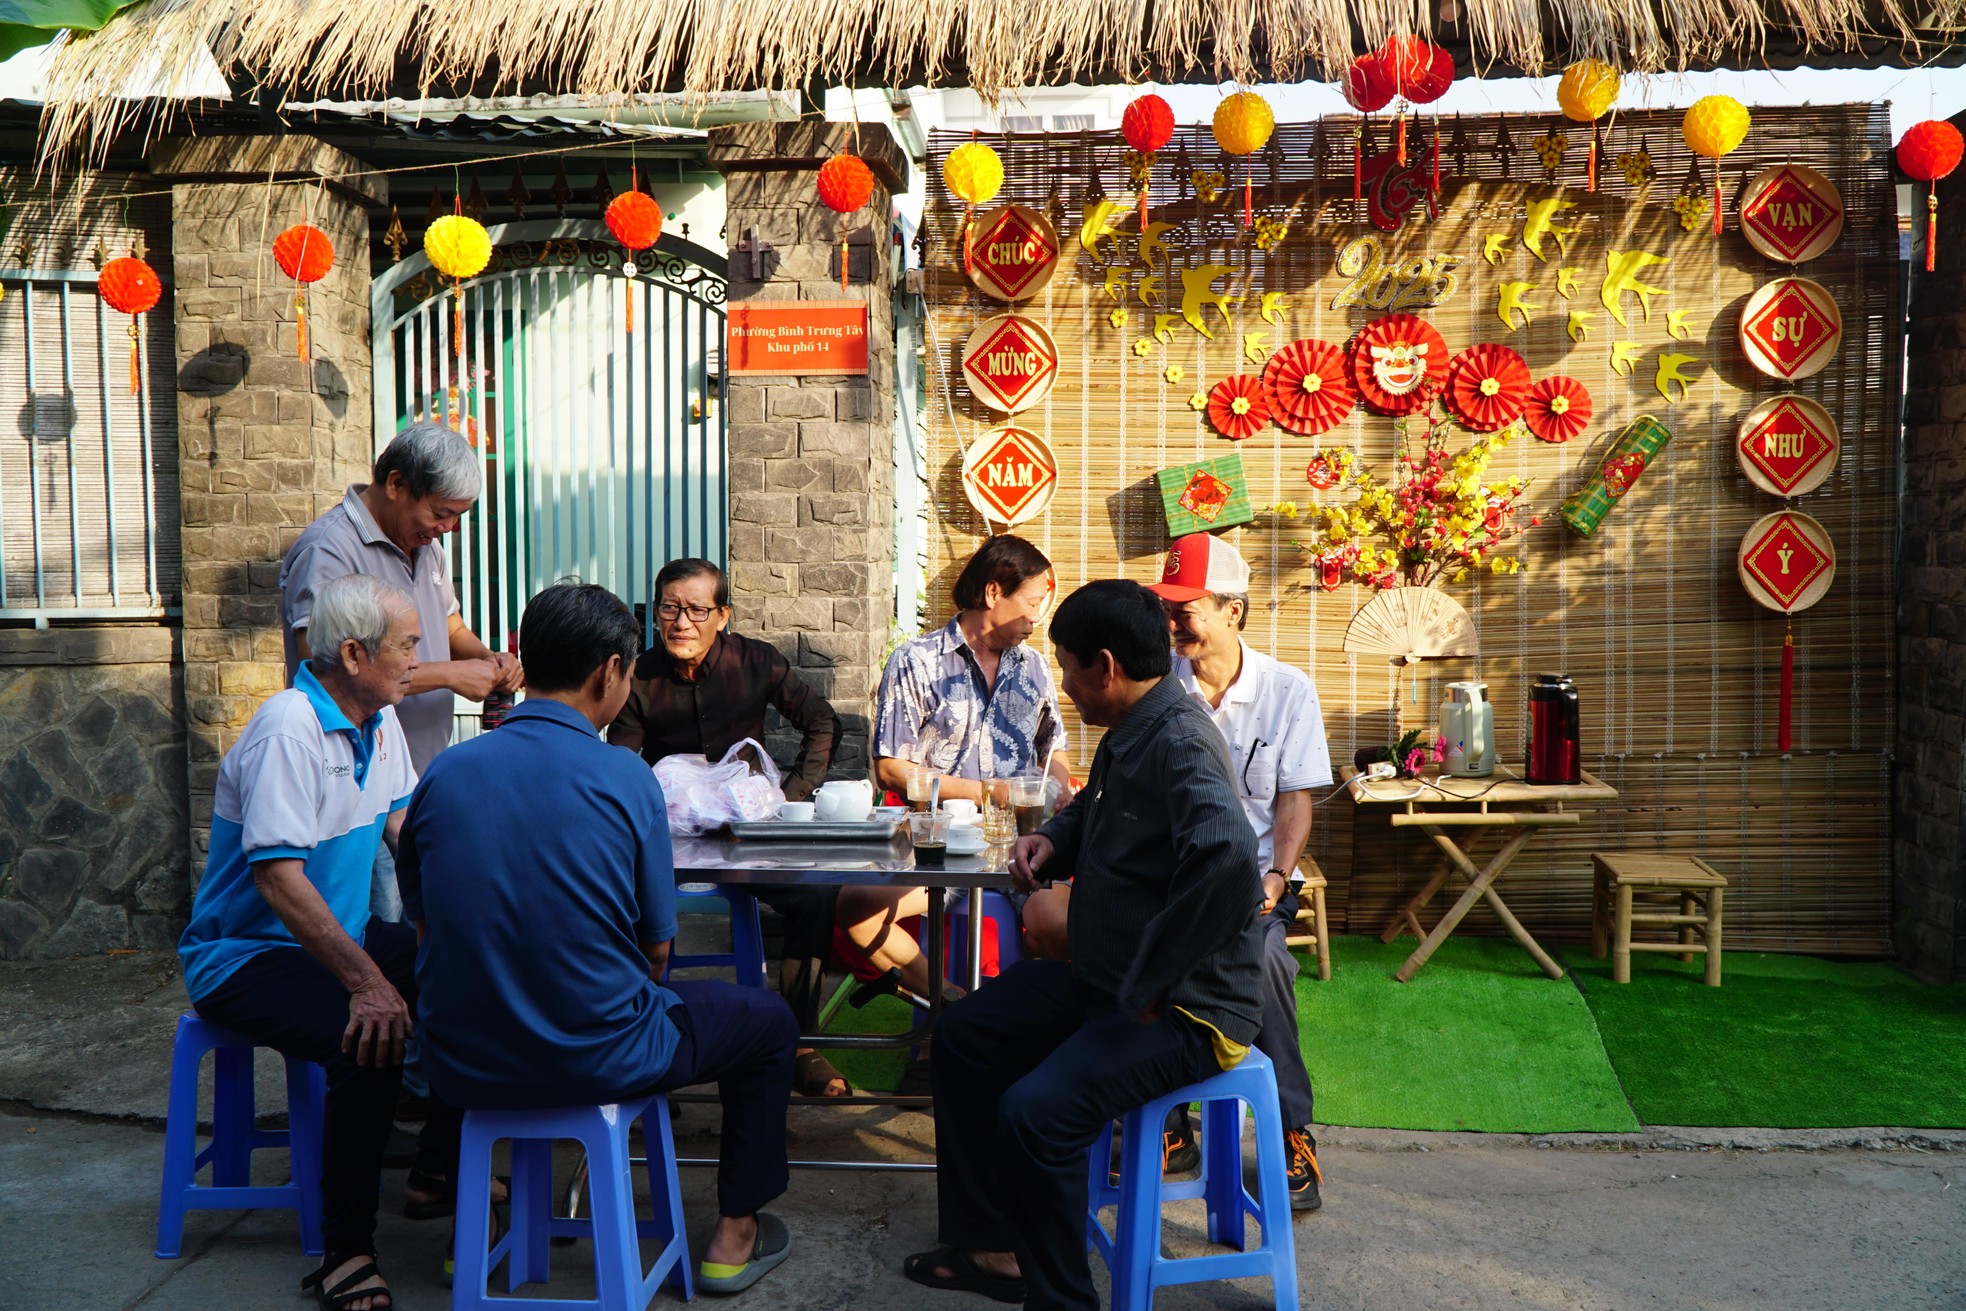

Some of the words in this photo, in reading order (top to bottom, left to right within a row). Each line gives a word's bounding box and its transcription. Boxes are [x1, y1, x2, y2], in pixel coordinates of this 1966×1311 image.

[1767, 203, 1812, 232] VẠN
[988, 236, 1035, 265] CHÚC
[1330, 235, 1471, 313] 2025
[731, 325, 776, 339] Phường
[778, 325, 804, 336] Bình
[806, 326, 843, 338] Trưng
[844, 325, 865, 338] Tây
[1772, 311, 1807, 347] SỰ
[767, 342, 790, 352] Khu
[793, 341, 814, 354] phố
[817, 341, 829, 352] 14
[988, 345, 1037, 376] MỪNG
[1764, 429, 1806, 458] NHƯ
[987, 456, 1034, 487] NĂM
[1777, 542, 1794, 575] Ý
